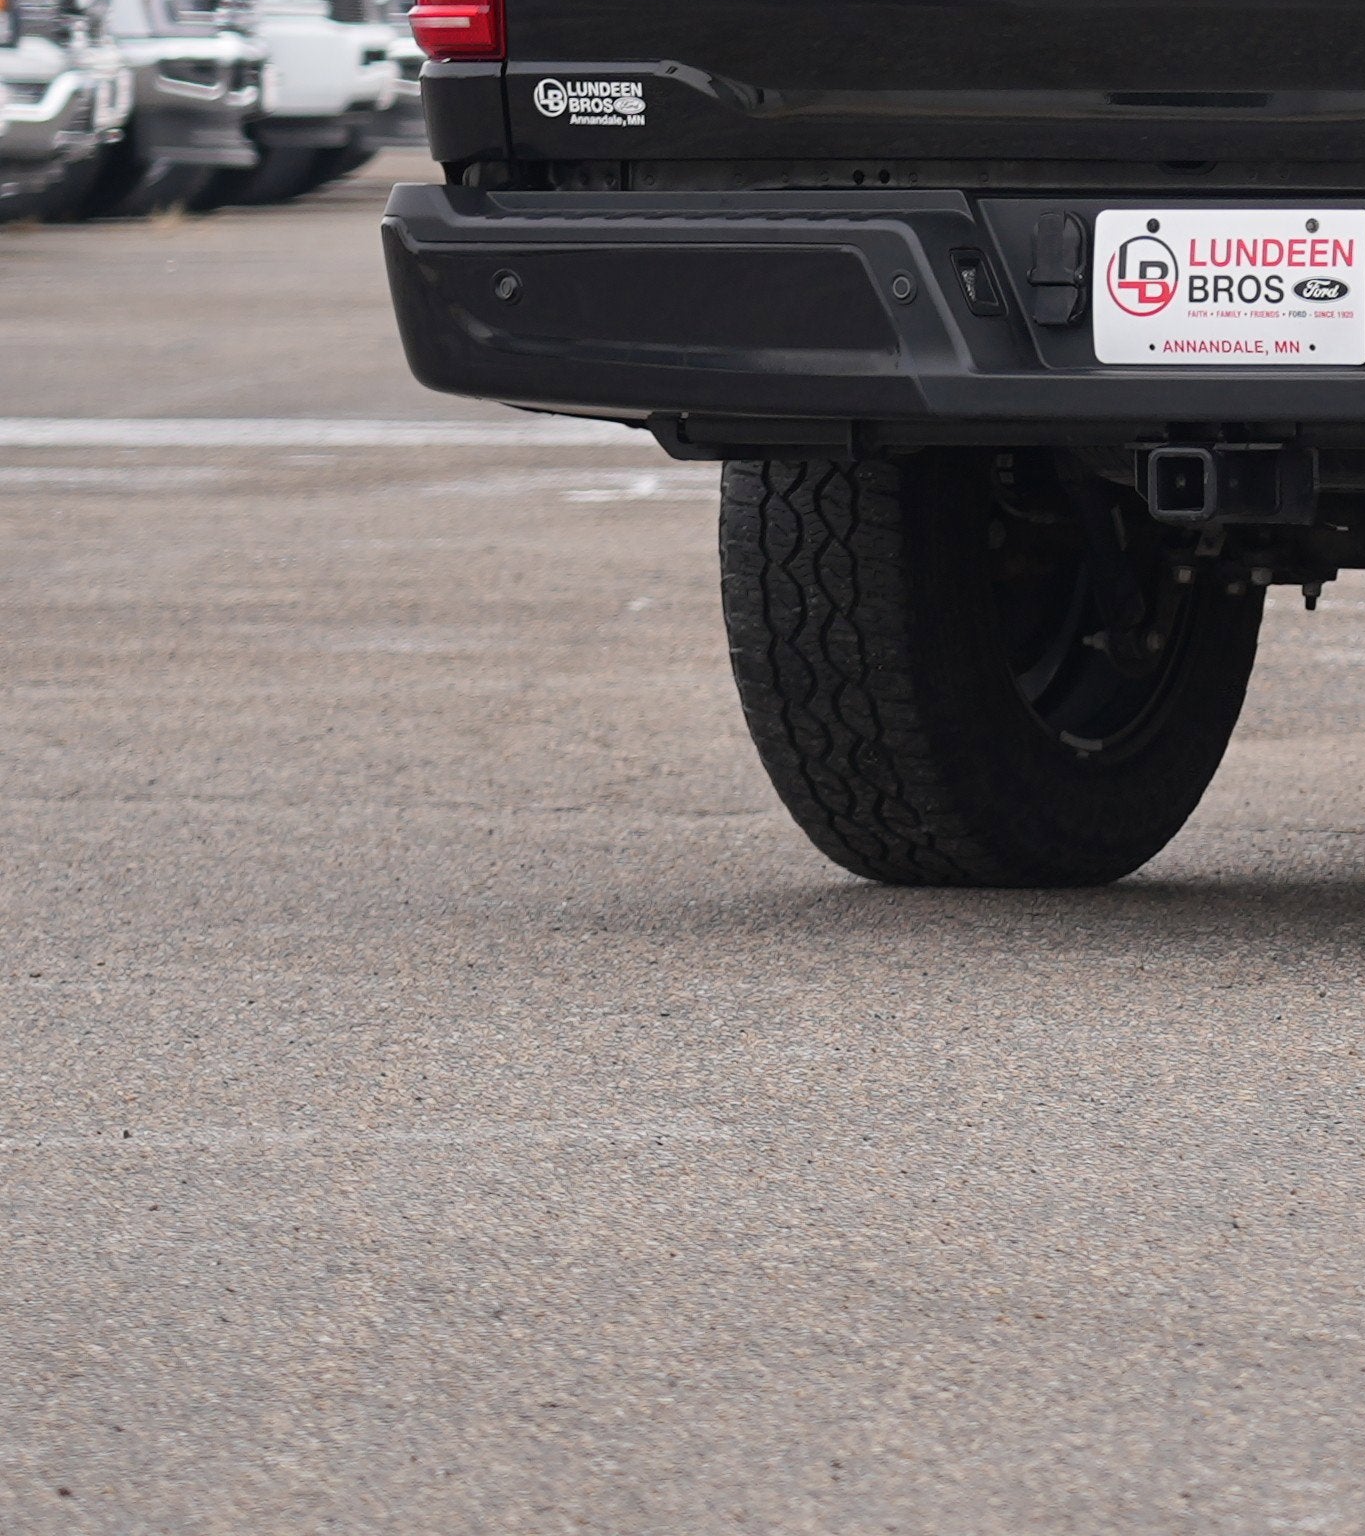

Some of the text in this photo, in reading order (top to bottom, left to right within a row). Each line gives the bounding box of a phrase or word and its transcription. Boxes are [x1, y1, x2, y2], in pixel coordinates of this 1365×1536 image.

[566, 81, 644, 97] LUNDEEN
[568, 98, 614, 113] BROS
[569, 114, 645, 127] Annandale, MN
[1189, 239, 1354, 267] LUNDEEN
[1188, 275, 1285, 303] BROS
[1162, 340, 1300, 356] ANNANDALE, MN
